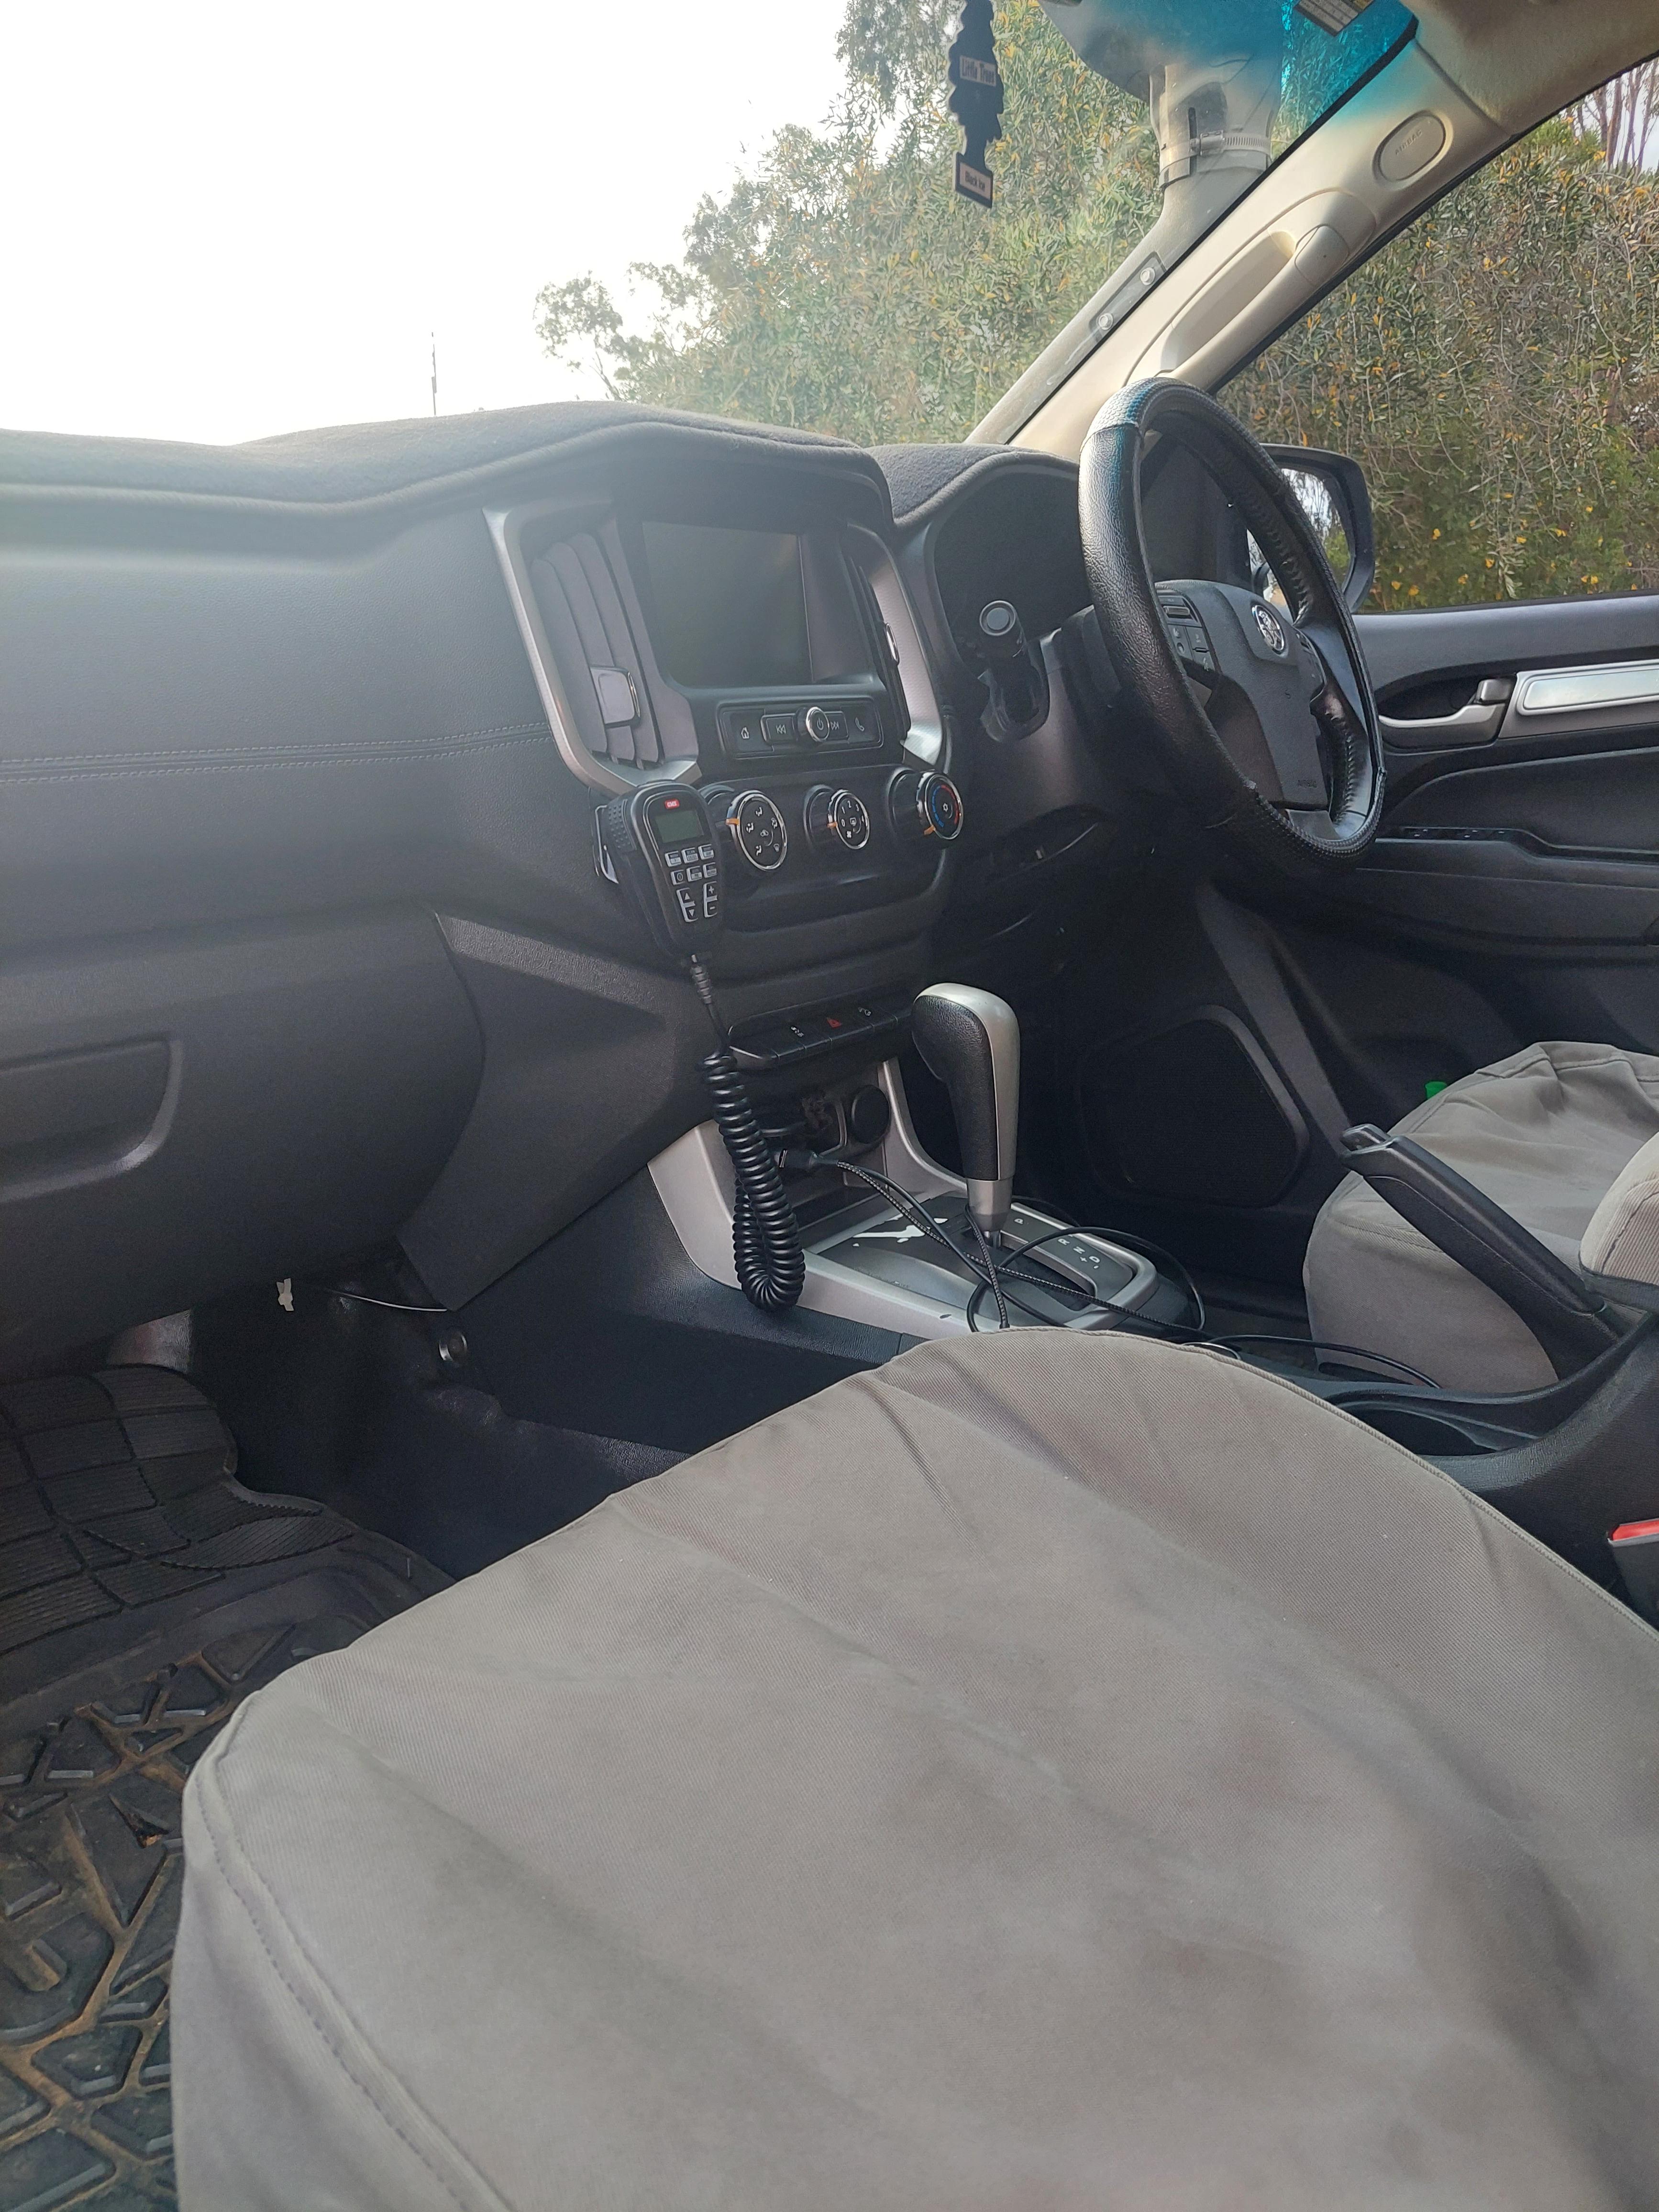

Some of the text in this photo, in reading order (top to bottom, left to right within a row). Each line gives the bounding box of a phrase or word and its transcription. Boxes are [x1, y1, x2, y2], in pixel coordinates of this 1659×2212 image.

[962, 58, 995, 85] Little Trees
[1395, 130, 1422, 155] AIRBAG
[965, 170, 977, 187] Black
[842, 806, 845, 814] 1
[855, 804, 860, 812] 3
[841, 818, 845, 827] 0
[861, 815, 864, 823] 4
[1073, 1246, 1086, 1254] N
[1088, 1255, 1101, 1263] D
